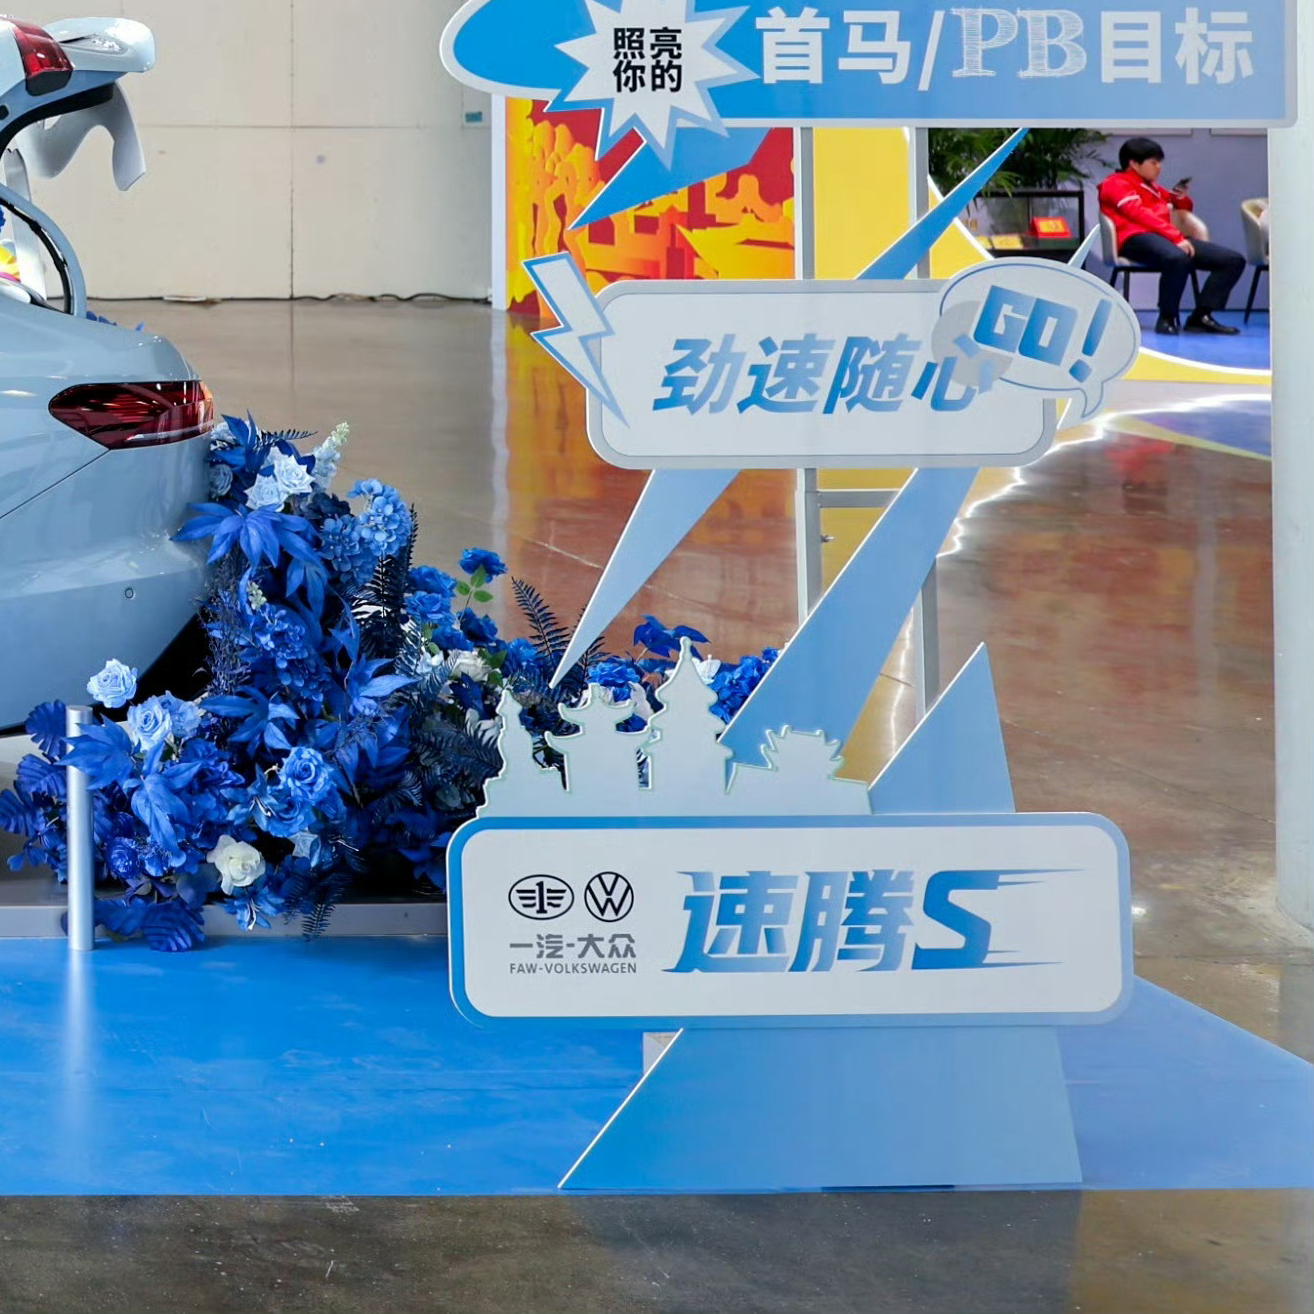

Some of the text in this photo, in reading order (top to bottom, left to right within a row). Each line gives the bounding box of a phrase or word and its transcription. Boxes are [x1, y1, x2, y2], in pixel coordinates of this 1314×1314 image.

[612, 59, 682, 93] 你的
[613, 26, 682, 59] 照亮
[755, 6, 1254, 91] 首马/PB目标
[652, 333, 994, 416] 劲速随心
[973, 284, 1113, 383] GO!
[662, 868, 1087, 974] 速腾S
[510, 962, 637, 974] FAW-VOLKSWAGEN
